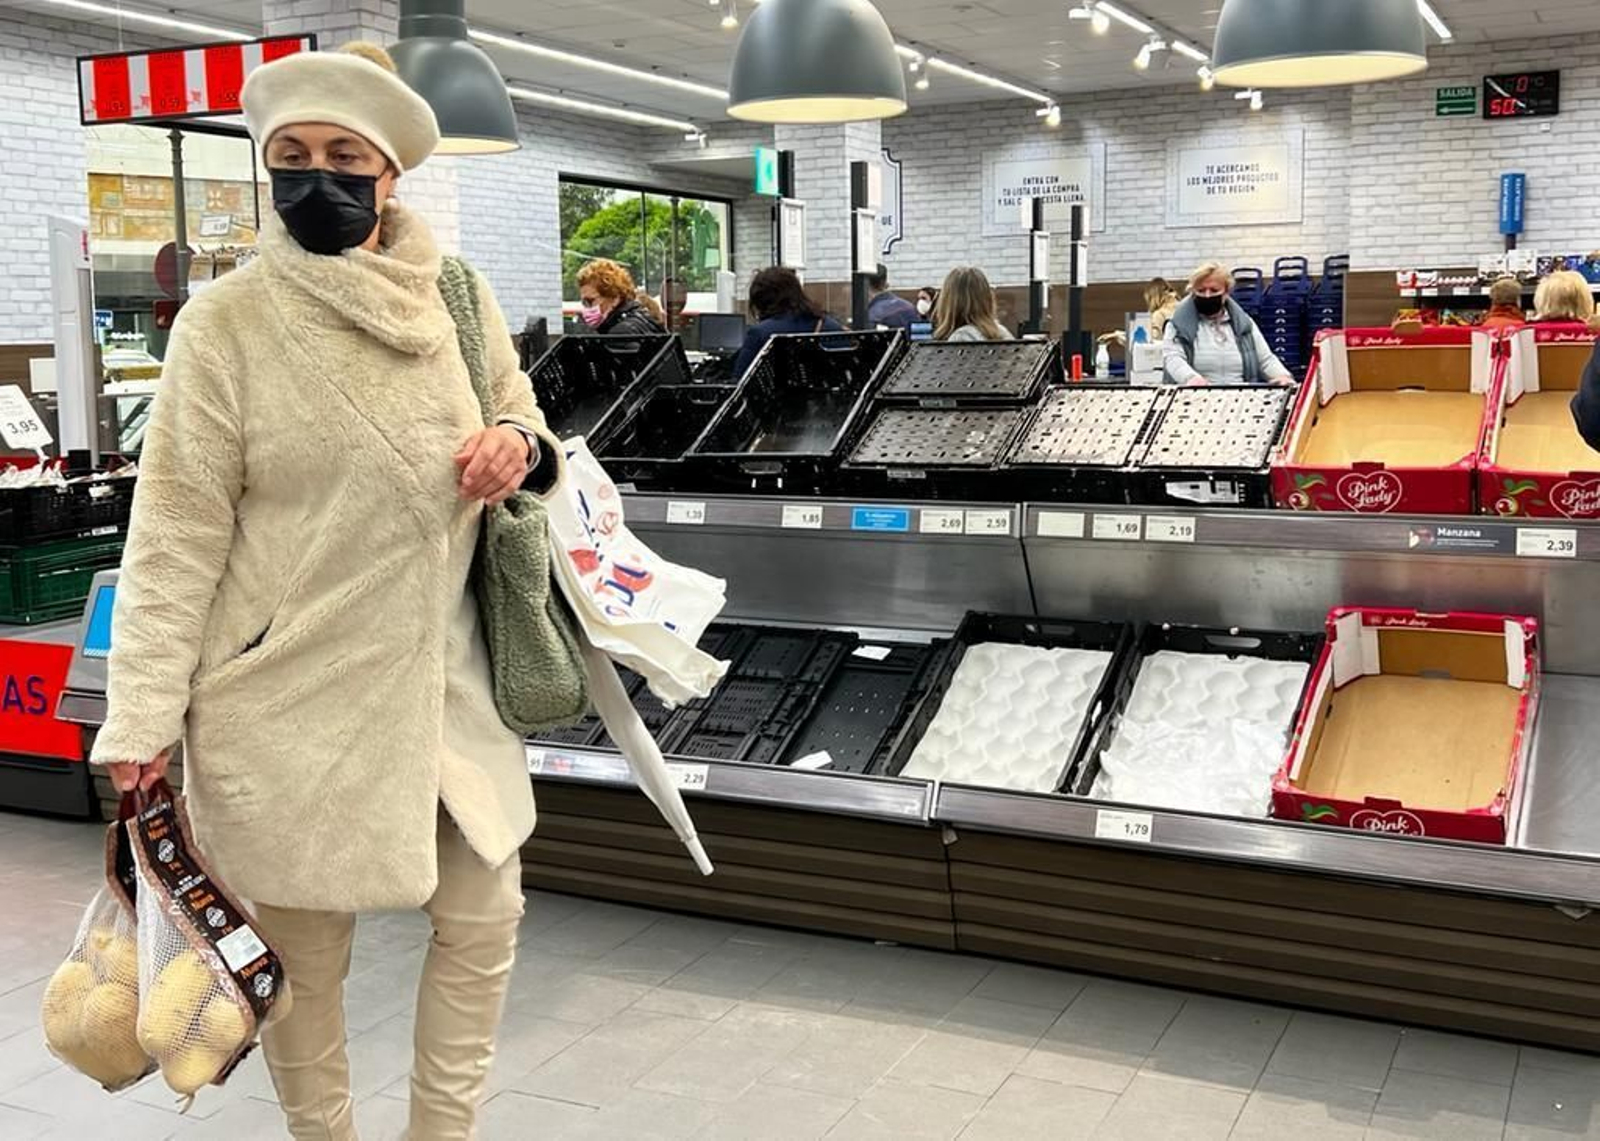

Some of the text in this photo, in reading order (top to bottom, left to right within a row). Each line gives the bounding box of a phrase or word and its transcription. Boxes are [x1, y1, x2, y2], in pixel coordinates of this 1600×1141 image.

[1439, 87, 1474, 99] SALIDA
[1206, 163, 1260, 174] TE ACERCAMOS
[1022, 175, 1059, 186] ENTRA CON
[1186, 172, 1279, 186] LOS MEJORES PRODUCTOS
[1003, 183, 1080, 196] TU LISTA DE LA COMPRA
[1206, 186, 1216, 194] DE
[1217, 185, 1227, 194] TU
[1003, 197, 1015, 206] SAL
[6, 420, 38, 434] 3,95
[1347, 475, 1389, 499] Pink
[1354, 489, 1397, 508] Lady
[941, 518, 961, 529] 2,69
[986, 518, 1007, 529] 2,59
[1116, 522, 1138, 535] 1,69
[1168, 525, 1192, 537] 2,19
[1437, 527, 1481, 538] Manzana
[1547, 540, 1574, 552] 2,39
[2, 674, 48, 716] AS
[684, 773, 704, 784] 2,29
[1124, 822, 1149, 836] 1,79
[1363, 815, 1410, 832] Pink
